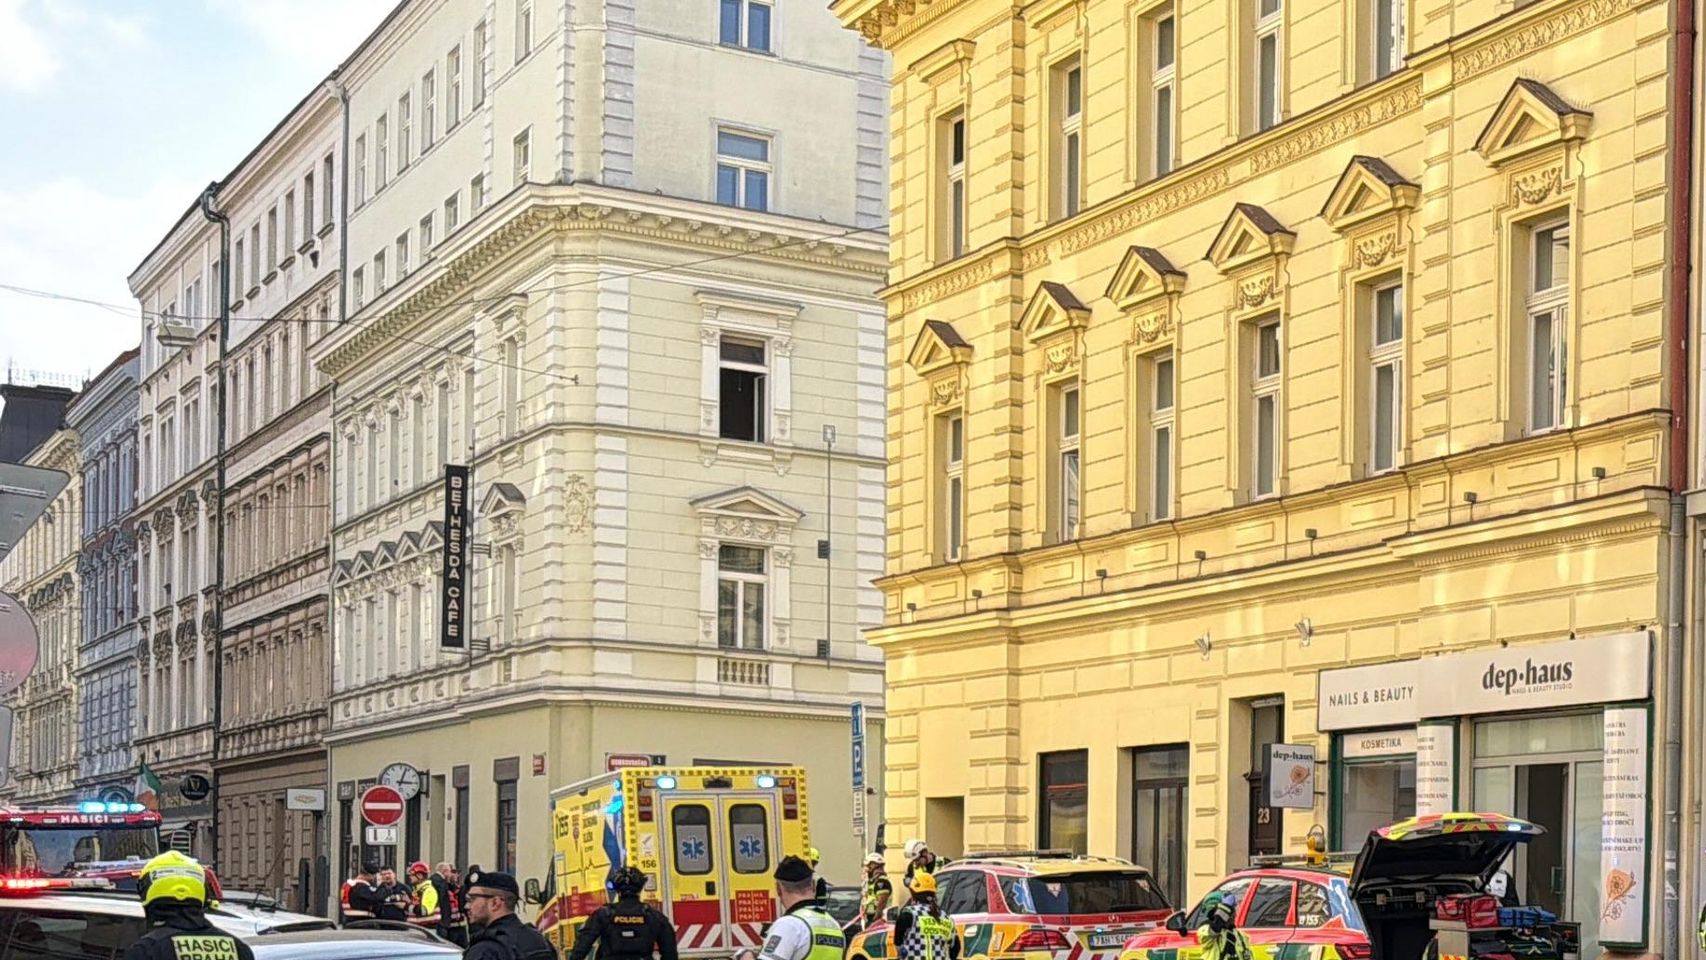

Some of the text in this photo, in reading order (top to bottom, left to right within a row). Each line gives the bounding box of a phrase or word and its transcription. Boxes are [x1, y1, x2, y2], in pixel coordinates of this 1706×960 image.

[447, 476, 462, 636] BETHESDA CAFE
[1329, 686, 1414, 707] NAILS & BEAUTY
[1360, 738, 1402, 750] KOSMETIKA
[1257, 807, 1270, 824] 23
[641, 860, 657, 868] 156
